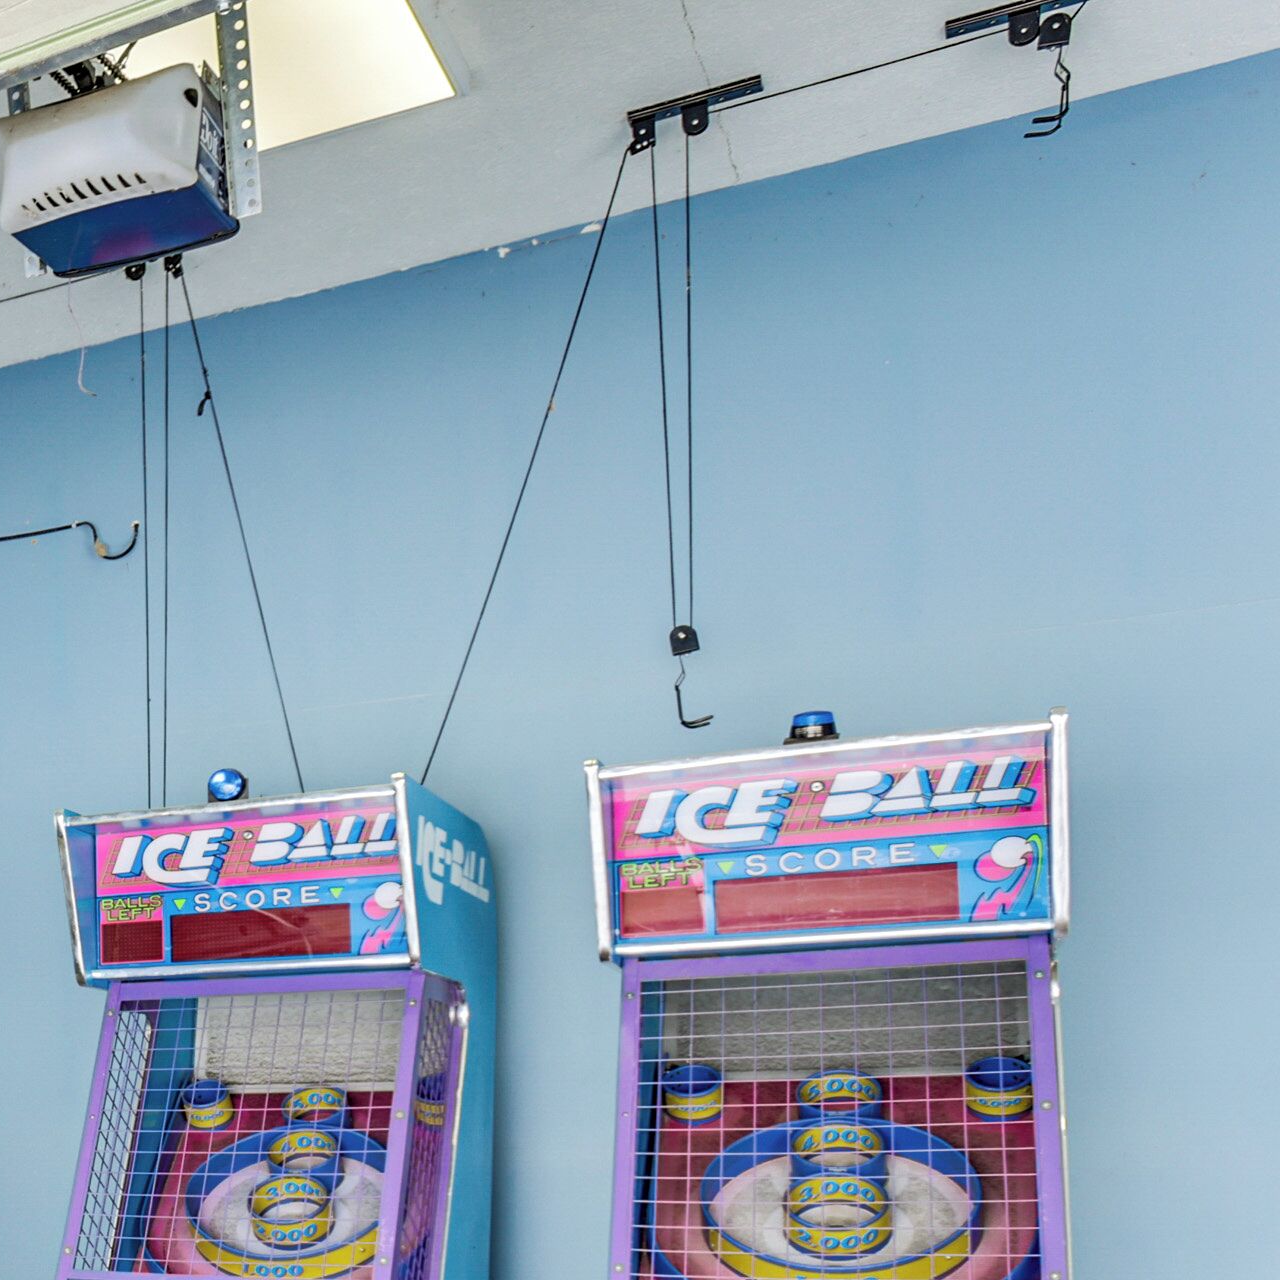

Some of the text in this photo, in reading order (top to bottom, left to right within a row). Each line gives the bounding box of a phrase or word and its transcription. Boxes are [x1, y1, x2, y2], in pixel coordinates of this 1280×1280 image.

[635, 755, 1037, 848] ICE BALL
[111, 812, 398, 887] ICE BALL
[744, 842, 917, 878] SCORE
[621, 857, 704, 876] BALLS
[629, 871, 692, 889] LEFT
[101, 894, 163, 911] BALLS
[194, 885, 321, 913] SCORE
[107, 906, 155, 922] LEFT
